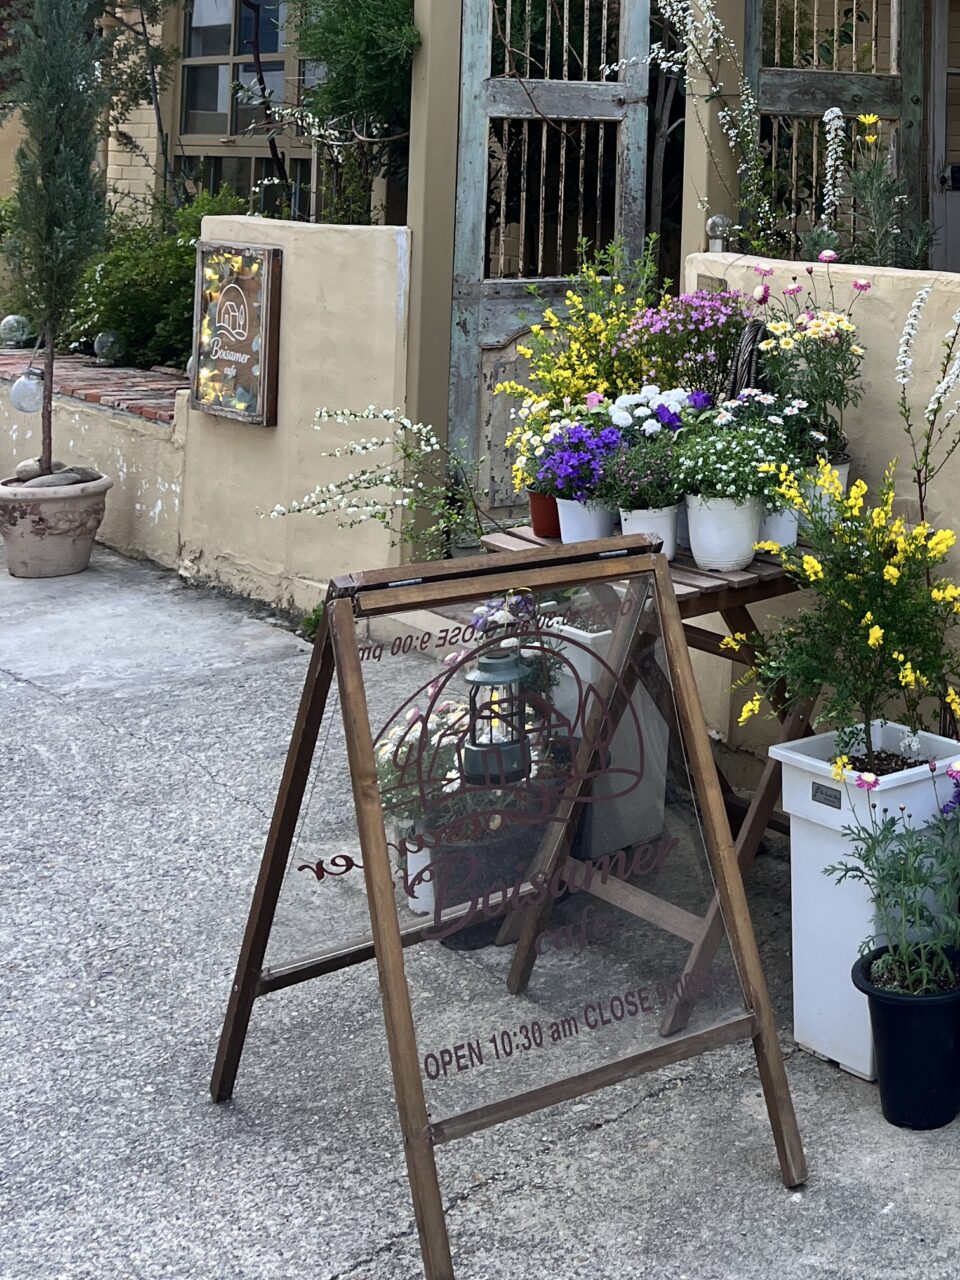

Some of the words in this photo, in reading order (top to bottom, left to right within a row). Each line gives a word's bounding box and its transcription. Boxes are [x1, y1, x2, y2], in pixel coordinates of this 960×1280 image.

[424, 1041, 483, 1080] OPEN
[489, 1021, 543, 1059] 10:30
[550, 1015, 579, 1042] am
[584, 987, 651, 1031] CLOSE
